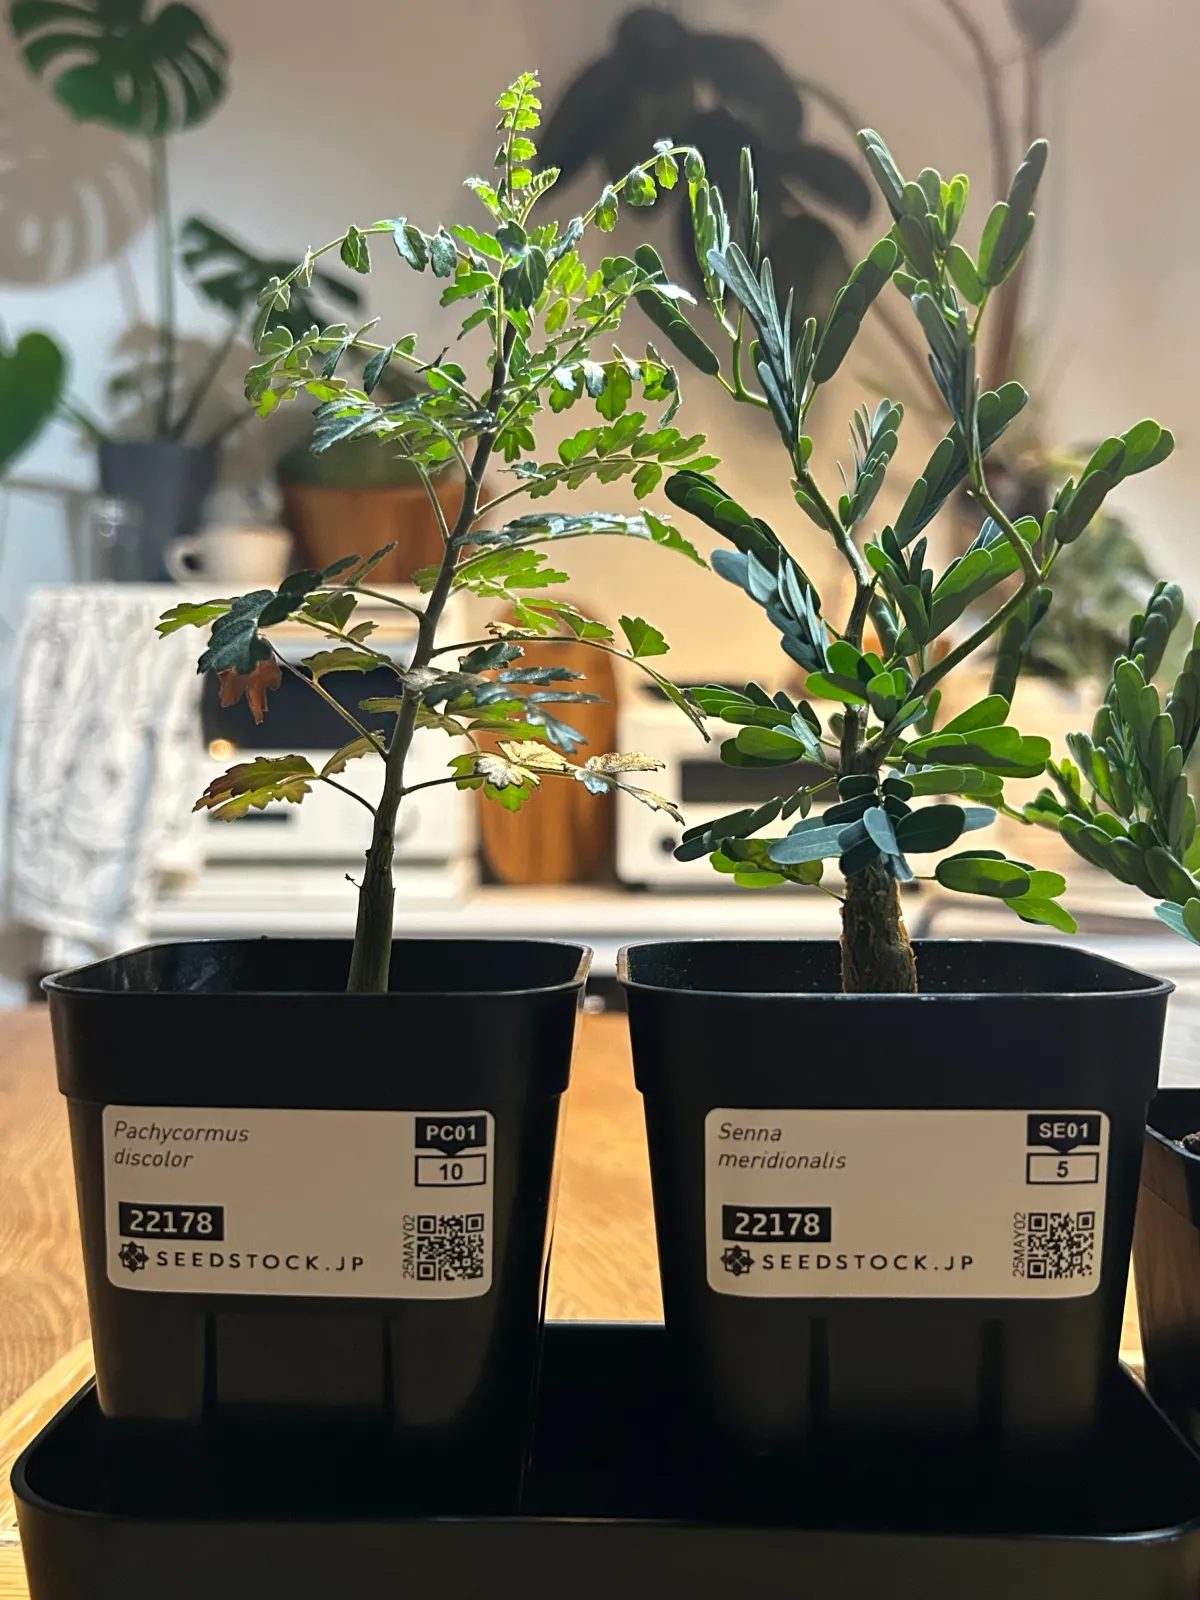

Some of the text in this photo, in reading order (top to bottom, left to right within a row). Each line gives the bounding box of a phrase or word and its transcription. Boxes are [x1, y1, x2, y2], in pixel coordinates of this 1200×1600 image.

[114, 1120, 249, 1143] Pachycormus
[426, 1124, 477, 1141] PC01
[718, 1122, 782, 1142] Senna
[1039, 1122, 1089, 1139] SE01
[114, 1148, 194, 1168] discolor
[717, 1150, 847, 1170] meridionalis
[439, 1162, 464, 1181] 10
[1056, 1160, 1069, 1178] 5
[129, 1209, 214, 1234] 22178
[734, 1212, 821, 1236] 22178
[402, 1214, 416, 1279] 25MAY02
[1012, 1211, 1026, 1278] 25MAY02
[156, 1250, 364, 1271] SEEDSTOCK.JP
[762, 1253, 974, 1271] SEEDSTOCK.JP
